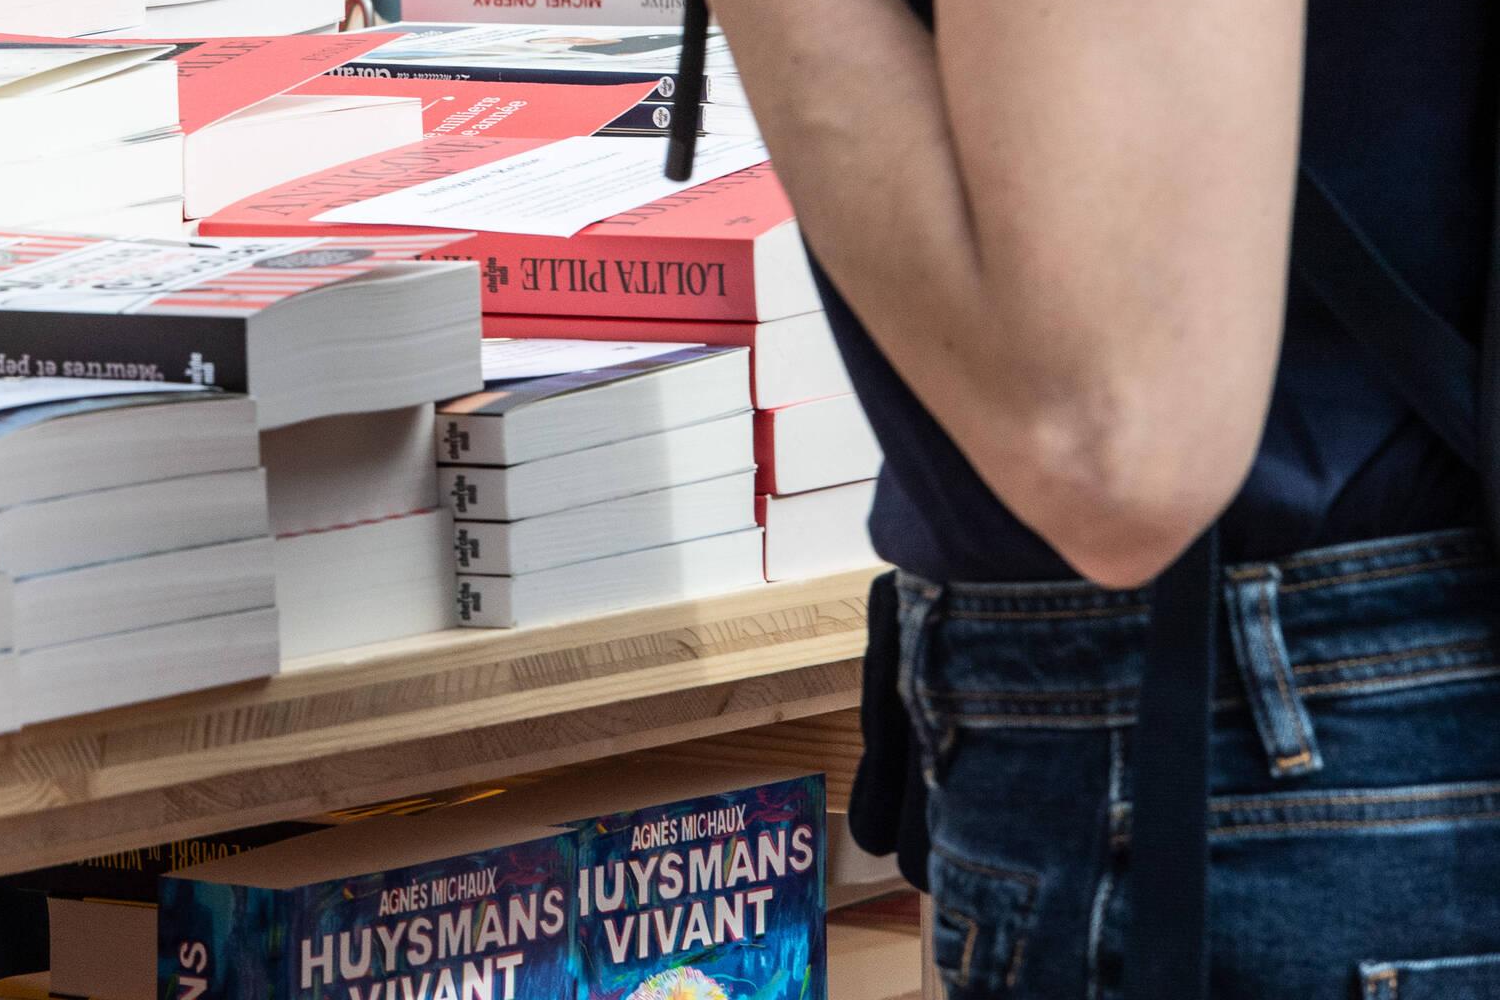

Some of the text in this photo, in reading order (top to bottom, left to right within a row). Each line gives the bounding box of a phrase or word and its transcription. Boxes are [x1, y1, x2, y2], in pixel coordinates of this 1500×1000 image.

[521, 257, 726, 296] LOLITA PILLE
[631, 803, 747, 851] AGNÈS MICHAUX
[378, 867, 497, 917] AGNÈS MICHAUX
[301, 887, 565, 989] HUYSMANS
[603, 886, 773, 964] VIVANT
